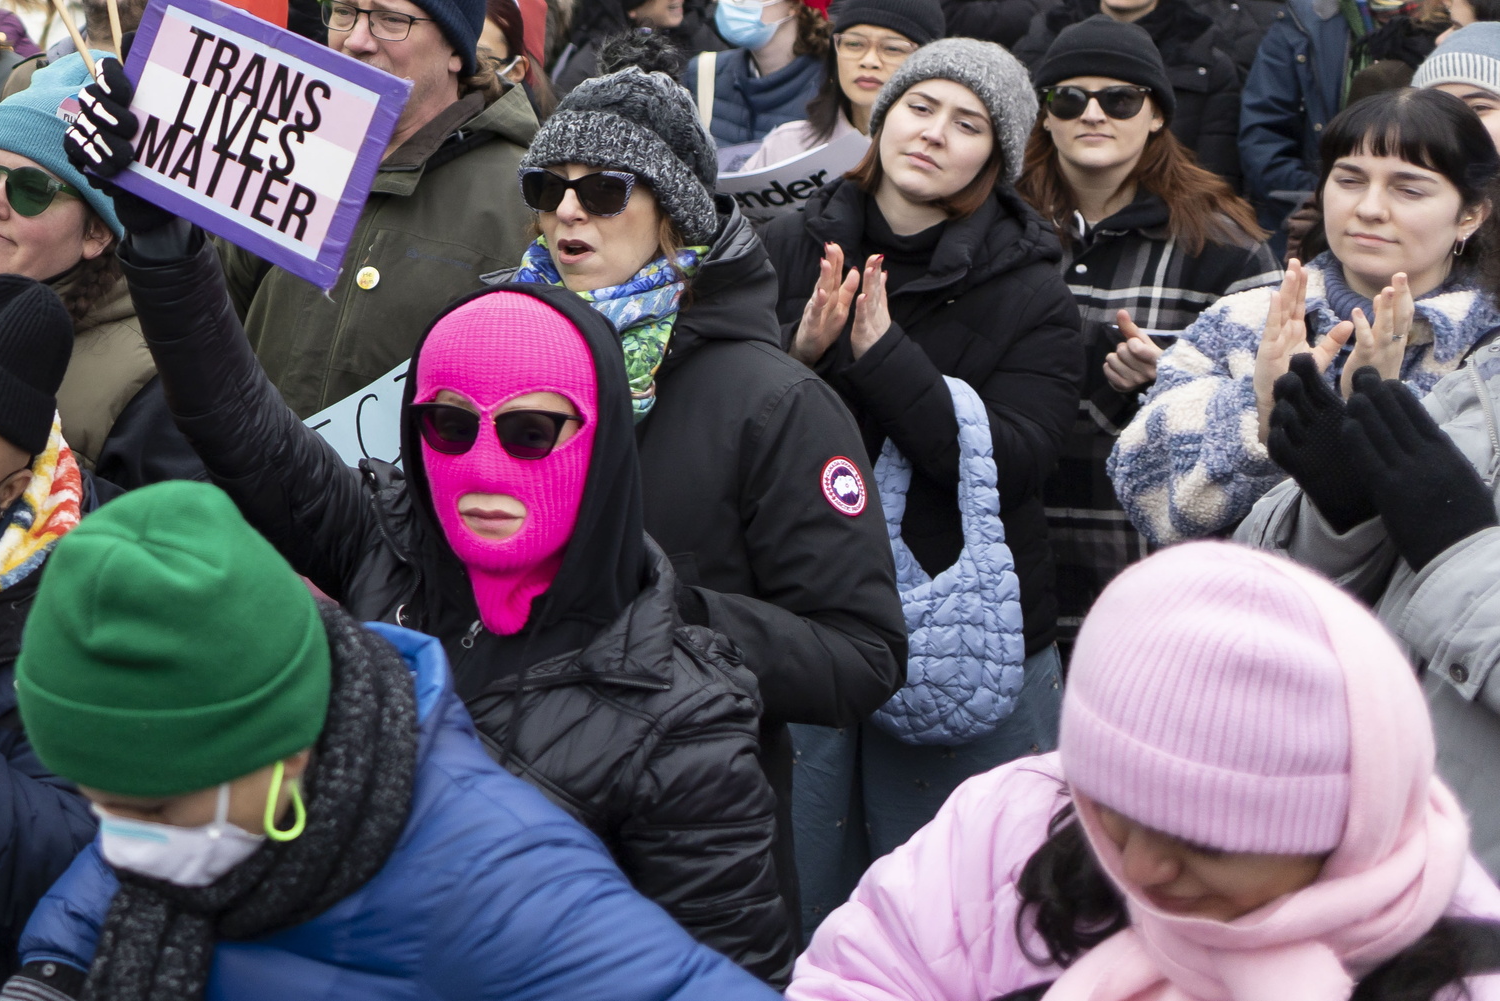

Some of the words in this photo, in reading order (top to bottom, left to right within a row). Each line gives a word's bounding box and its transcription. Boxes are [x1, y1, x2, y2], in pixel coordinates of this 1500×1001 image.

[173, 78, 305, 178] LIVES
[183, 25, 331, 133] TRANS
[134, 114, 317, 242] MATTER
